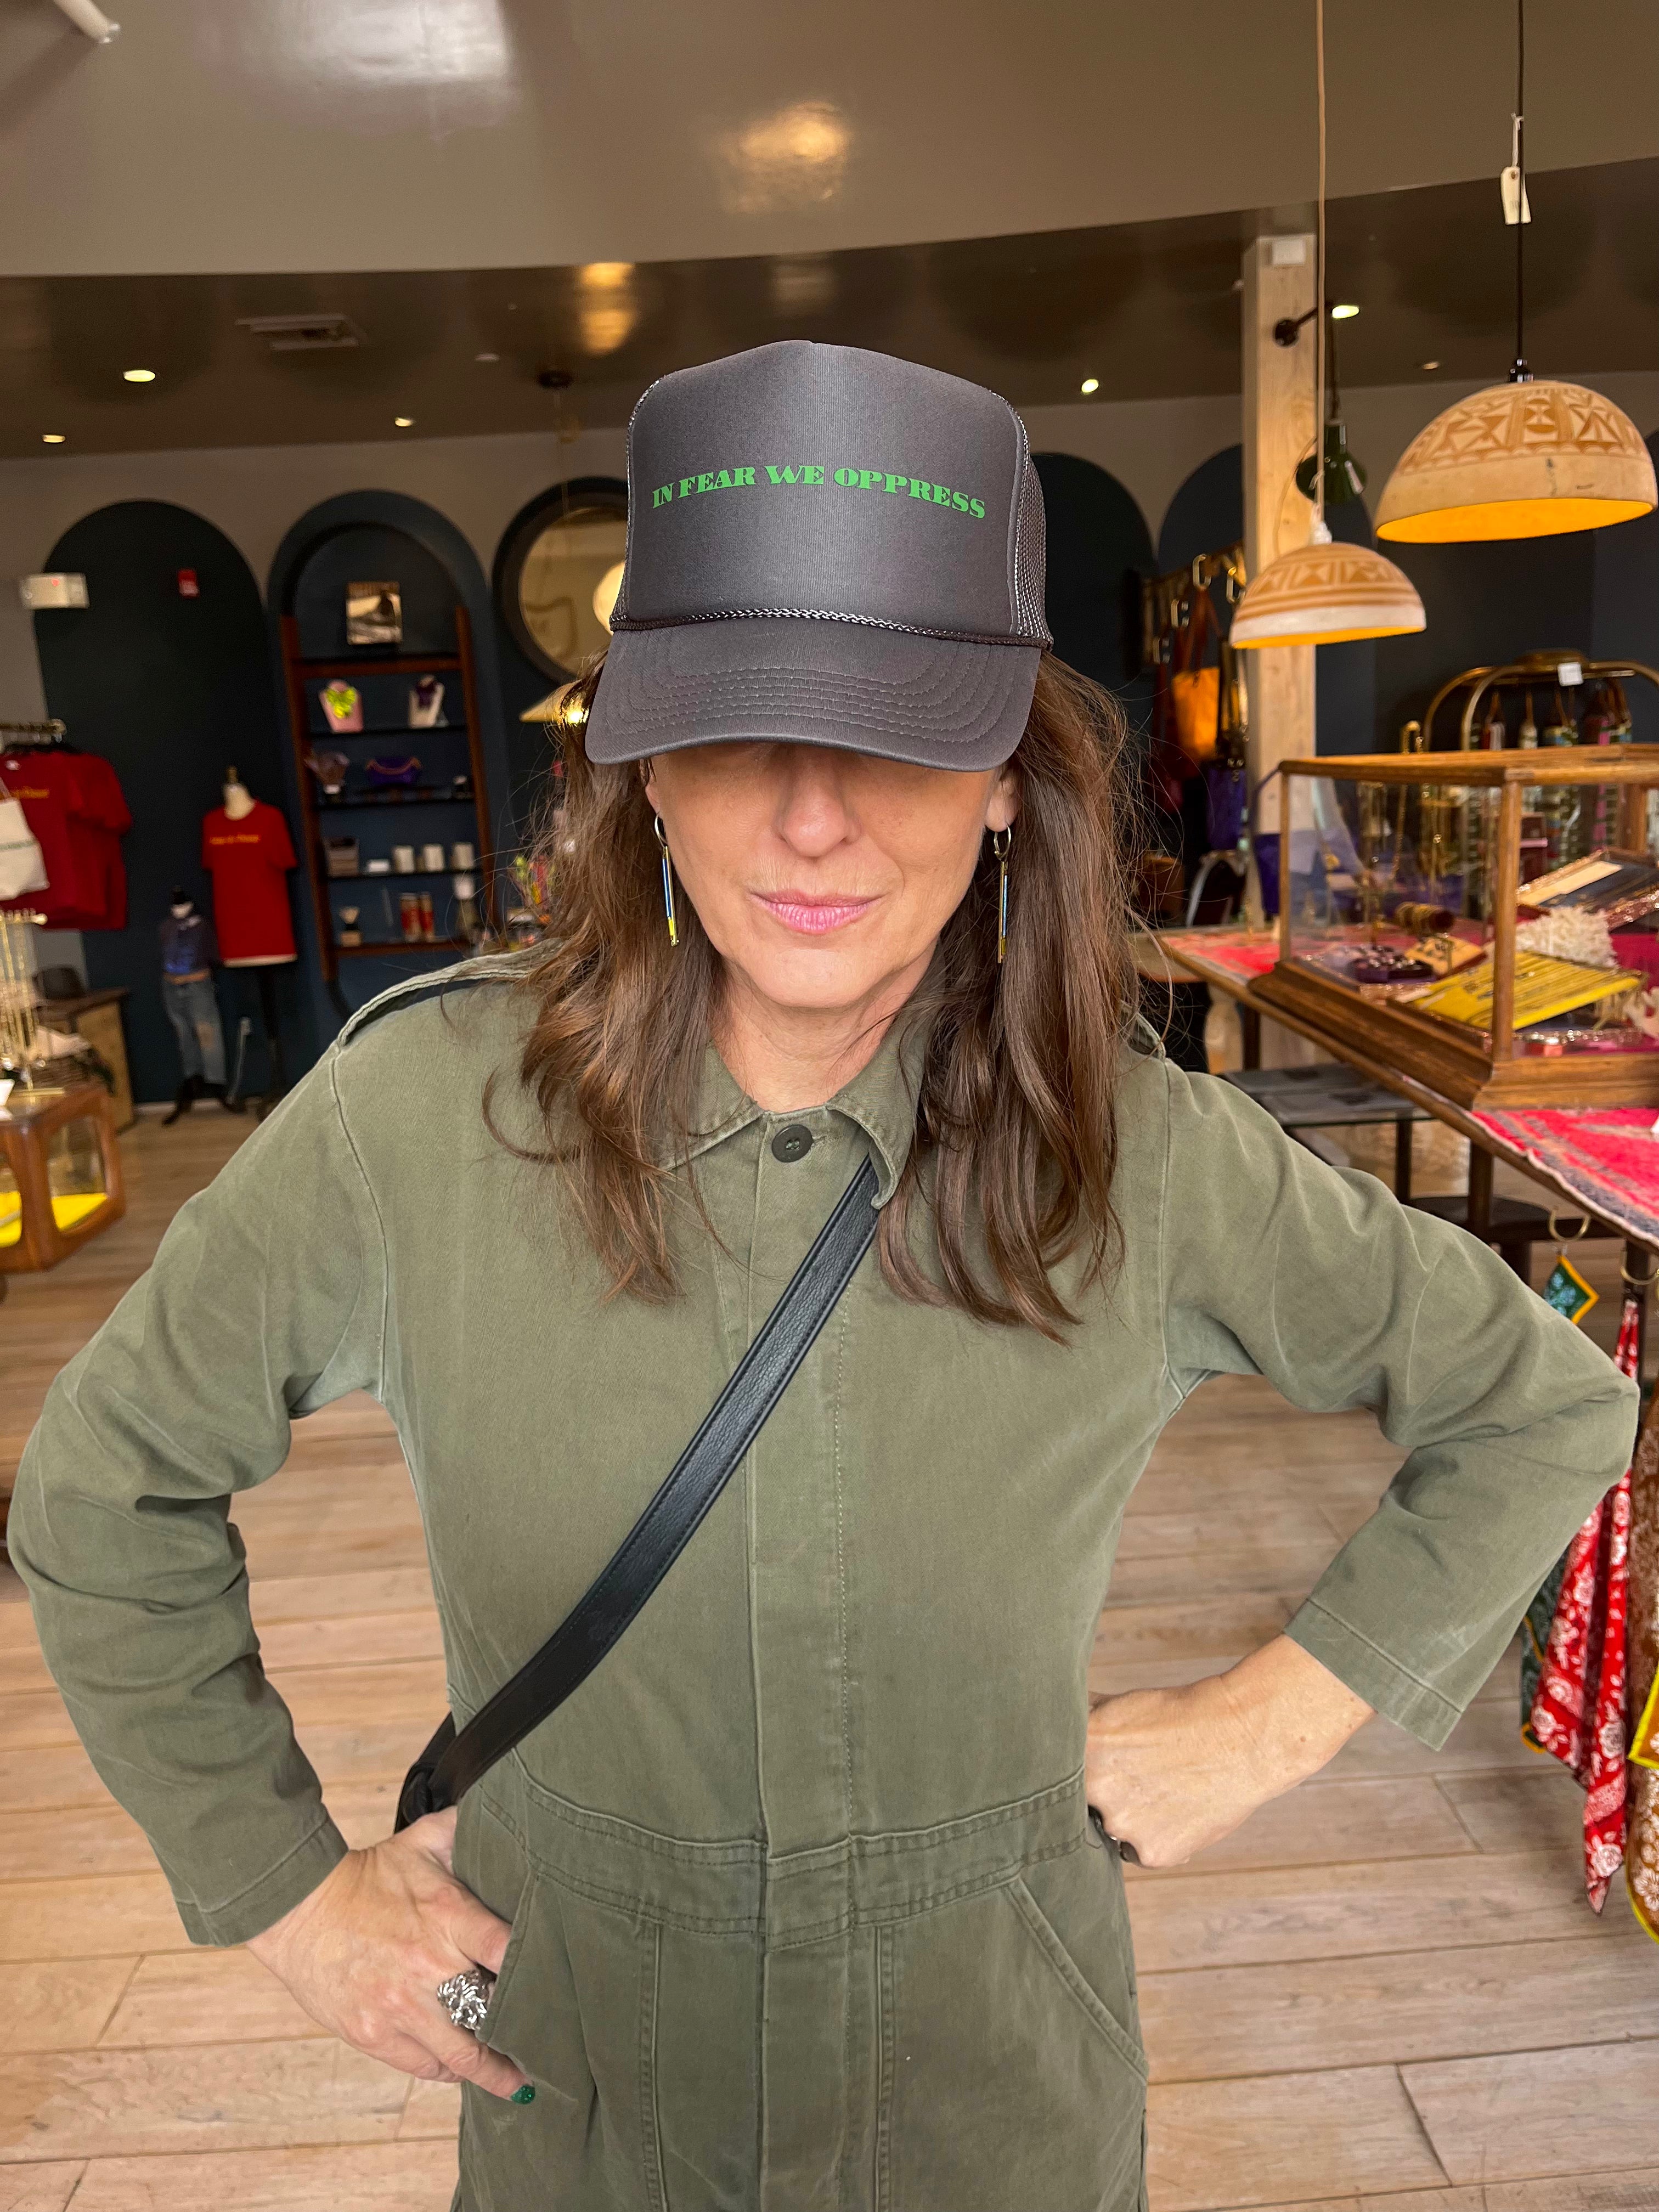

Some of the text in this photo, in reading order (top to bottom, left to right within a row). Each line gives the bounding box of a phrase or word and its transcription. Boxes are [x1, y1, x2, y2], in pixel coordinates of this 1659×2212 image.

[652, 465, 986, 519] IN FEAR WE OPPRESS
